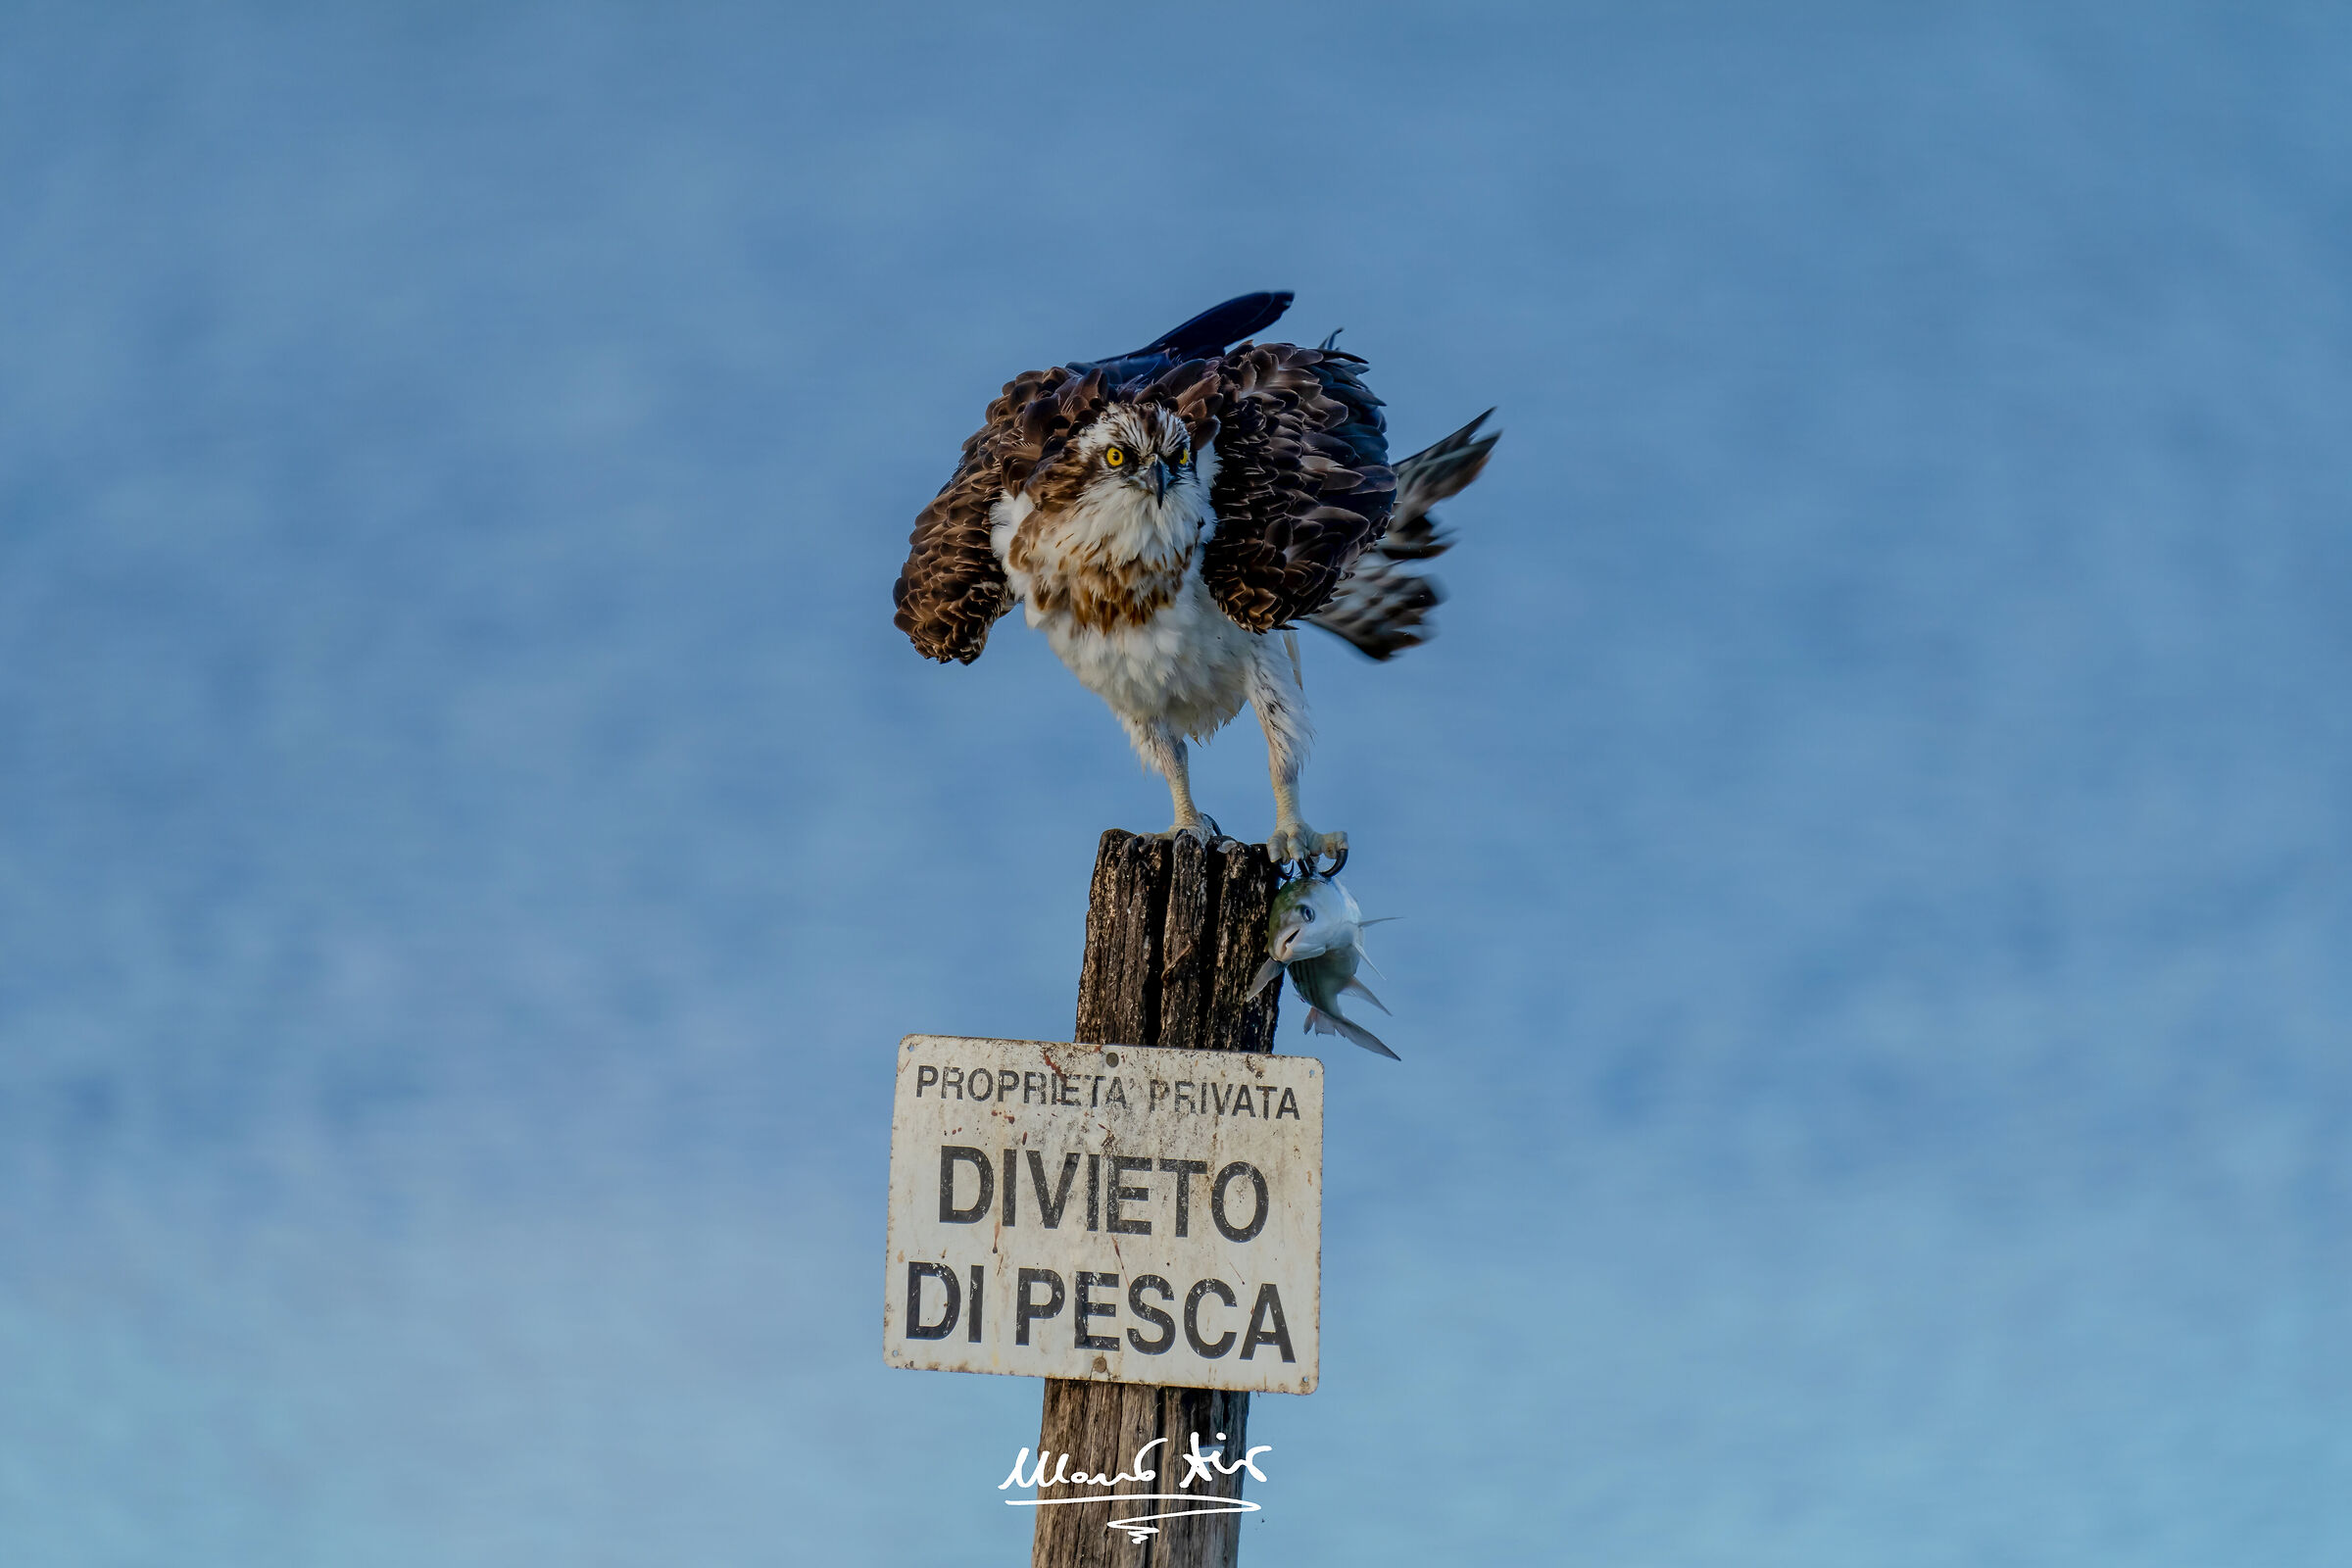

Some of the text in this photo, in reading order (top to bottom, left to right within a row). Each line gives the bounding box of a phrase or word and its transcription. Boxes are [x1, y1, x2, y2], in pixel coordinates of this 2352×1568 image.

[1149, 1081, 1300, 1120] PRIVATA
[939, 1145, 1269, 1243] DIVIETO
[906, 1260, 1296, 1363] DI PESCA
